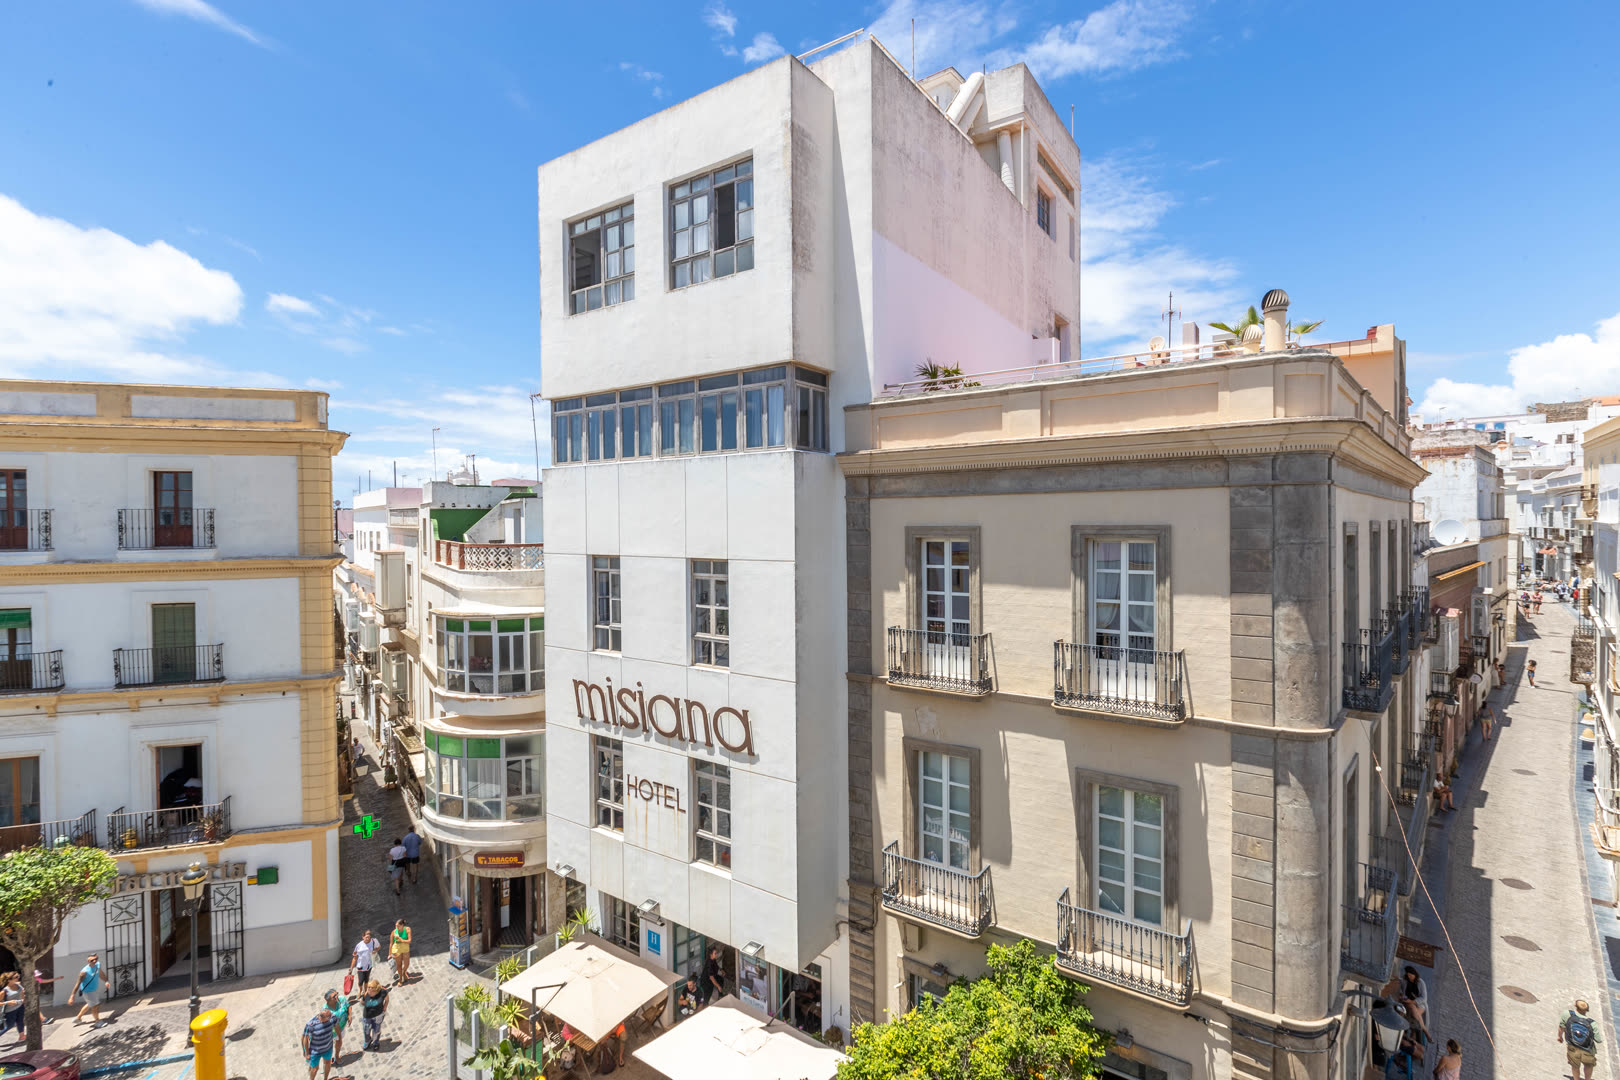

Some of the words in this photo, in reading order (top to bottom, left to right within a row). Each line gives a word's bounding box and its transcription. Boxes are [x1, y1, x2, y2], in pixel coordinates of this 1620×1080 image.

[572, 676, 755, 757] misiana
[626, 773, 686, 814] HOTEL
[111, 861, 246, 894] farmcia
